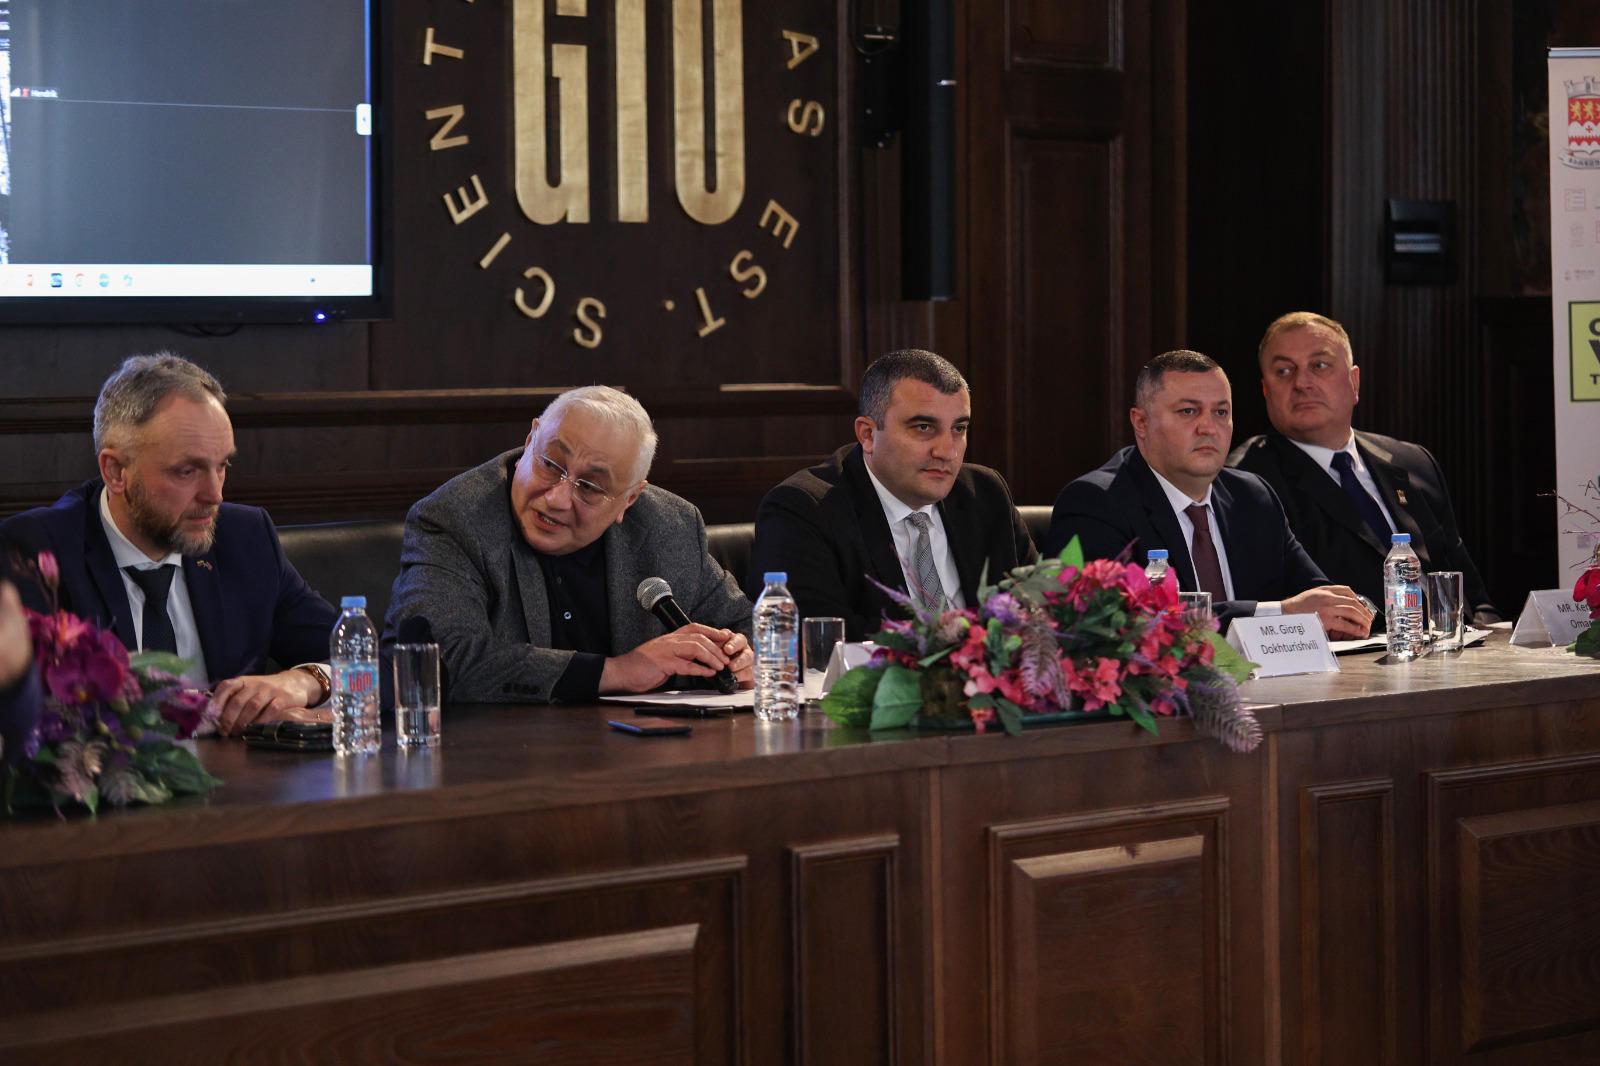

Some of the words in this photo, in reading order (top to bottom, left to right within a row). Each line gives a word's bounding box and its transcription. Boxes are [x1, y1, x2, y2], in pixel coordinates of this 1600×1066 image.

[423, 0, 607, 349] SCIENT
[1557, 603, 1575, 613] MR.
[1260, 625, 1278, 636] MR.
[1279, 623, 1305, 636] Giorgi
